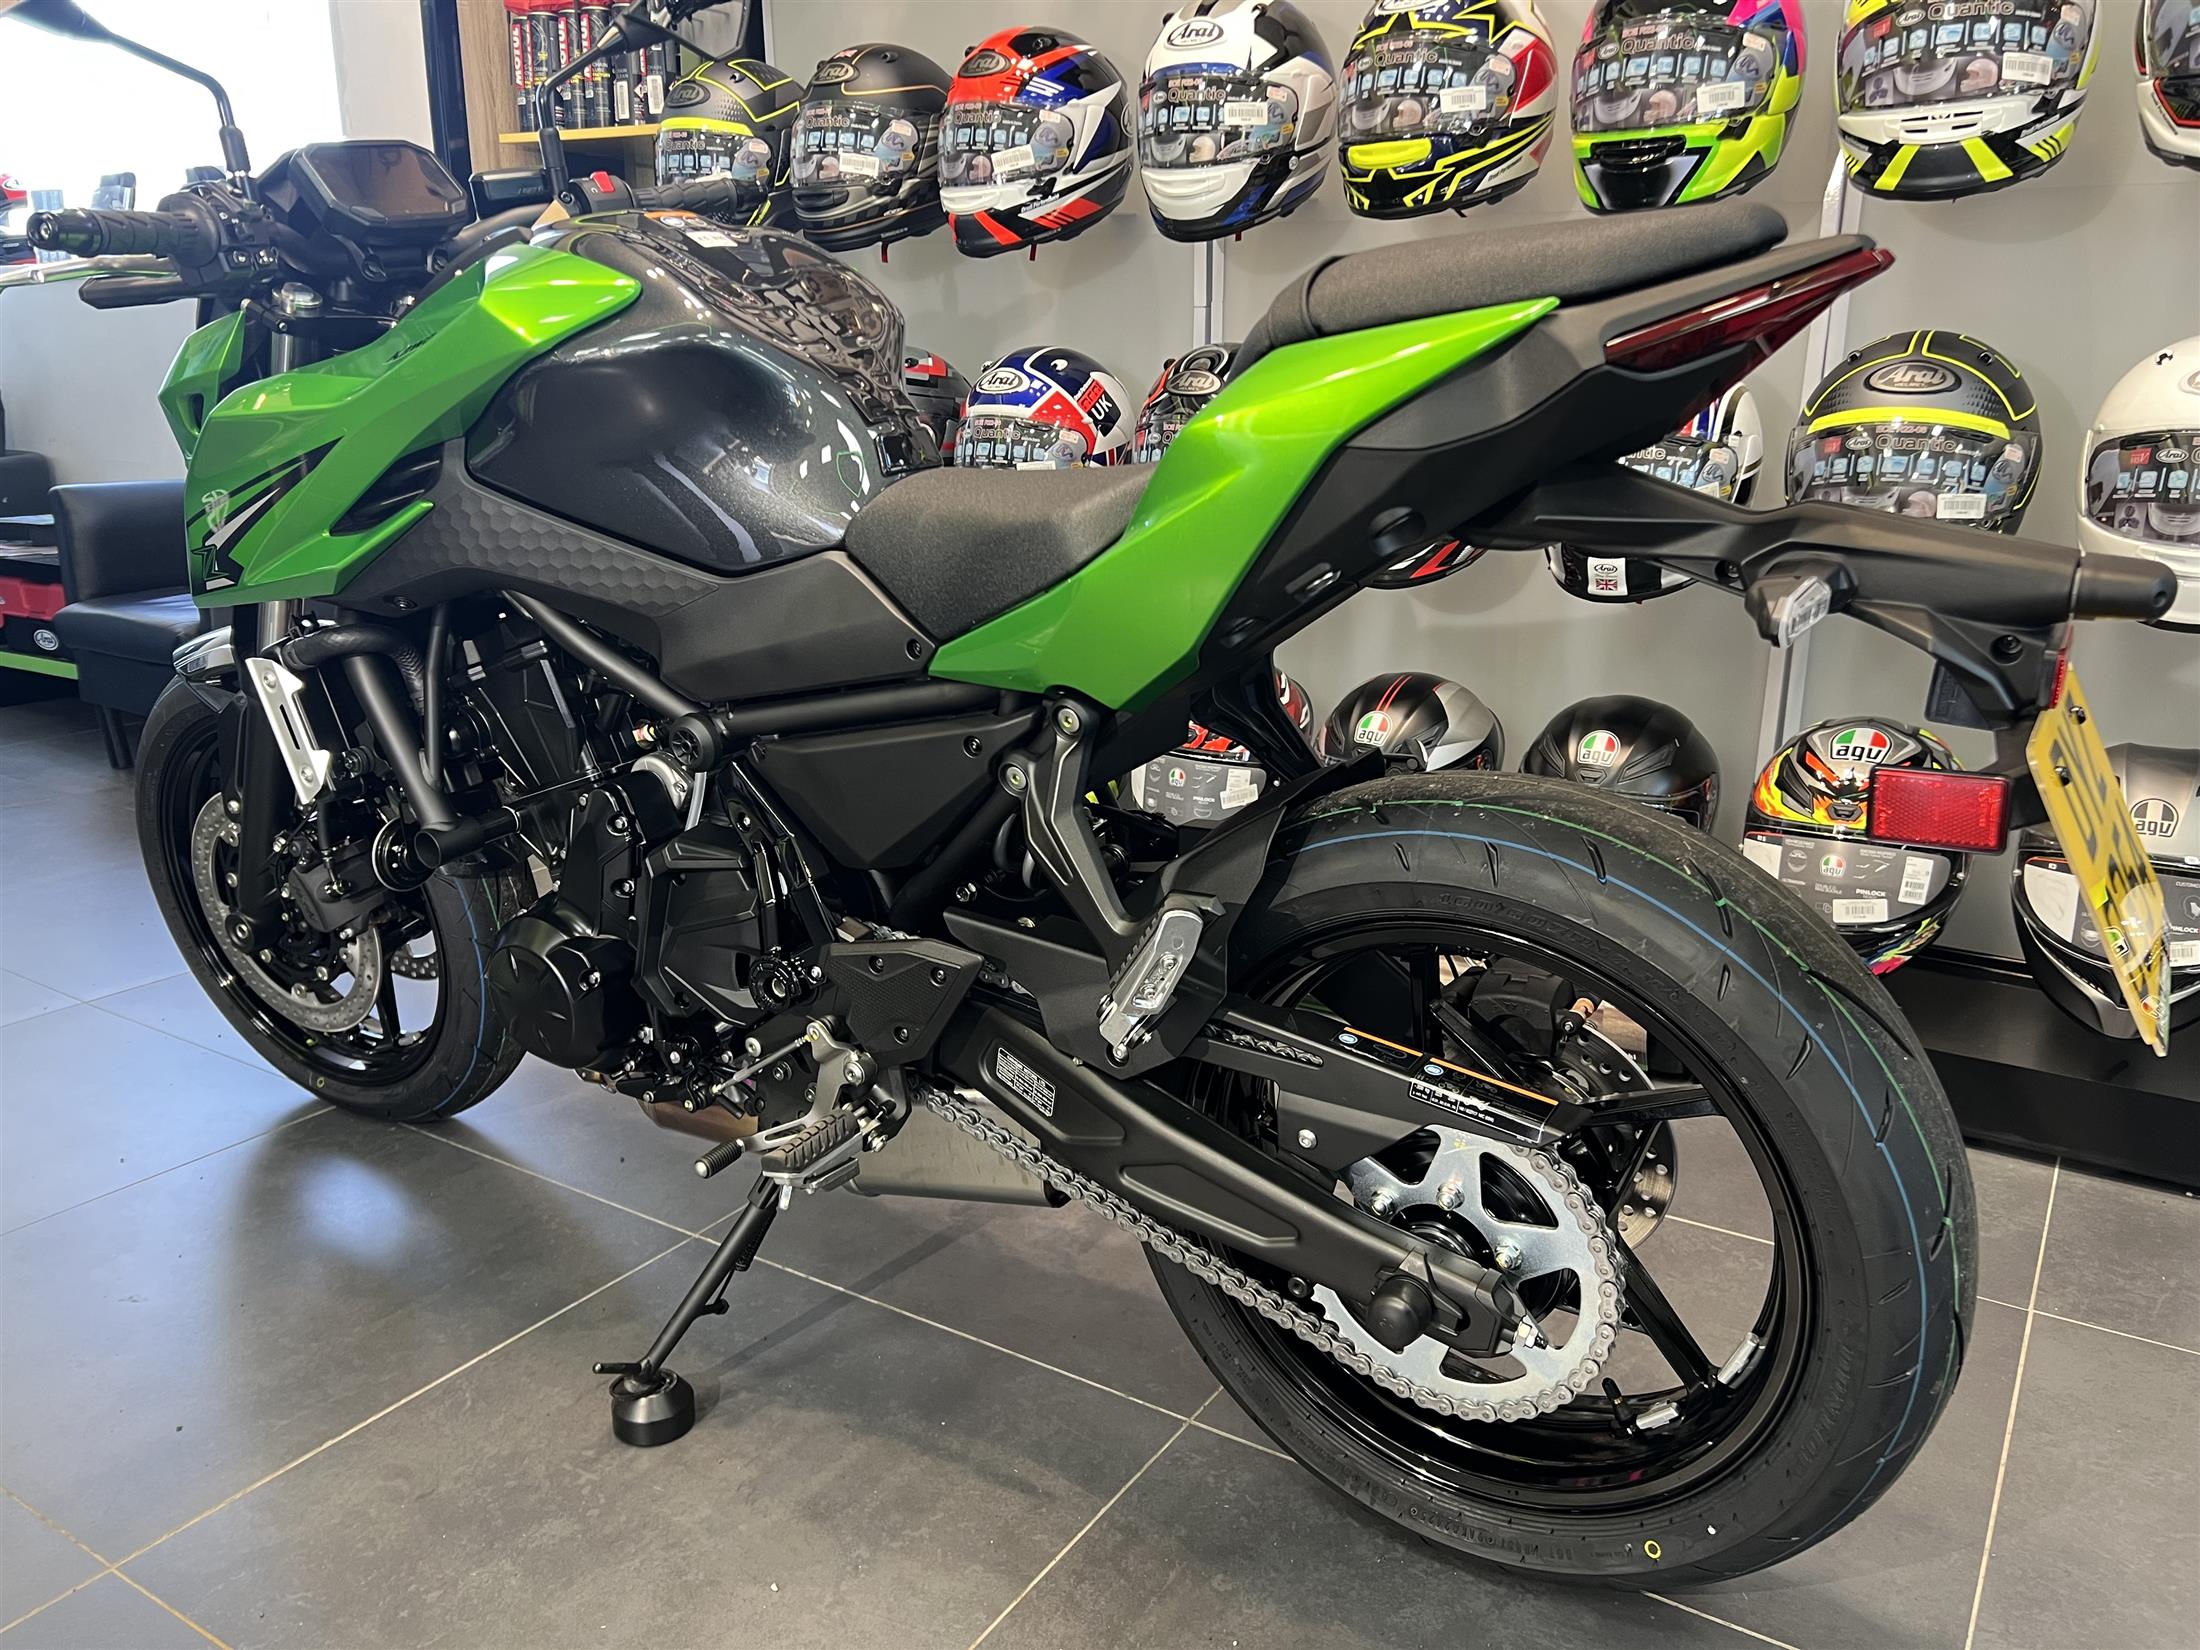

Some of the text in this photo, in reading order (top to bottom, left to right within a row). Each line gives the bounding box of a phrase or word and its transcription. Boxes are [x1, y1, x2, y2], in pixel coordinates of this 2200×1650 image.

[1899, 11, 1920, 22] Arai
[1928, 1, 2014, 20] Quantic
[1180, 23, 1215, 39] Arai
[1621, 33, 1695, 54] Quantic
[513, 27, 524, 86] MOTUL
[1374, 50, 1438, 67] Quantic
[1168, 87, 1226, 103] Quantic
[806, 115, 849, 128] Quantic
[954, 111, 1001, 124] Quantic
[665, 138, 705, 150] Quantic
[982, 373, 1016, 386] Arai
[1173, 373, 1212, 387] Arai
[1885, 365, 1947, 384] Arai
[1091, 394, 1112, 420] UK
[974, 427, 1020, 440] Quantic
[1848, 438, 1871, 448] Arai
[1875, 436, 1956, 453] Quantic
[2159, 450, 2185, 460] Arai
[1597, 565, 1615, 573] Arai
[1358, 730, 1384, 745] agv
[1582, 750, 1613, 765] agv
[1836, 745, 1883, 762] agv
[2135, 820, 2172, 834] agv
[1856, 888, 1886, 897] PINLOCK
